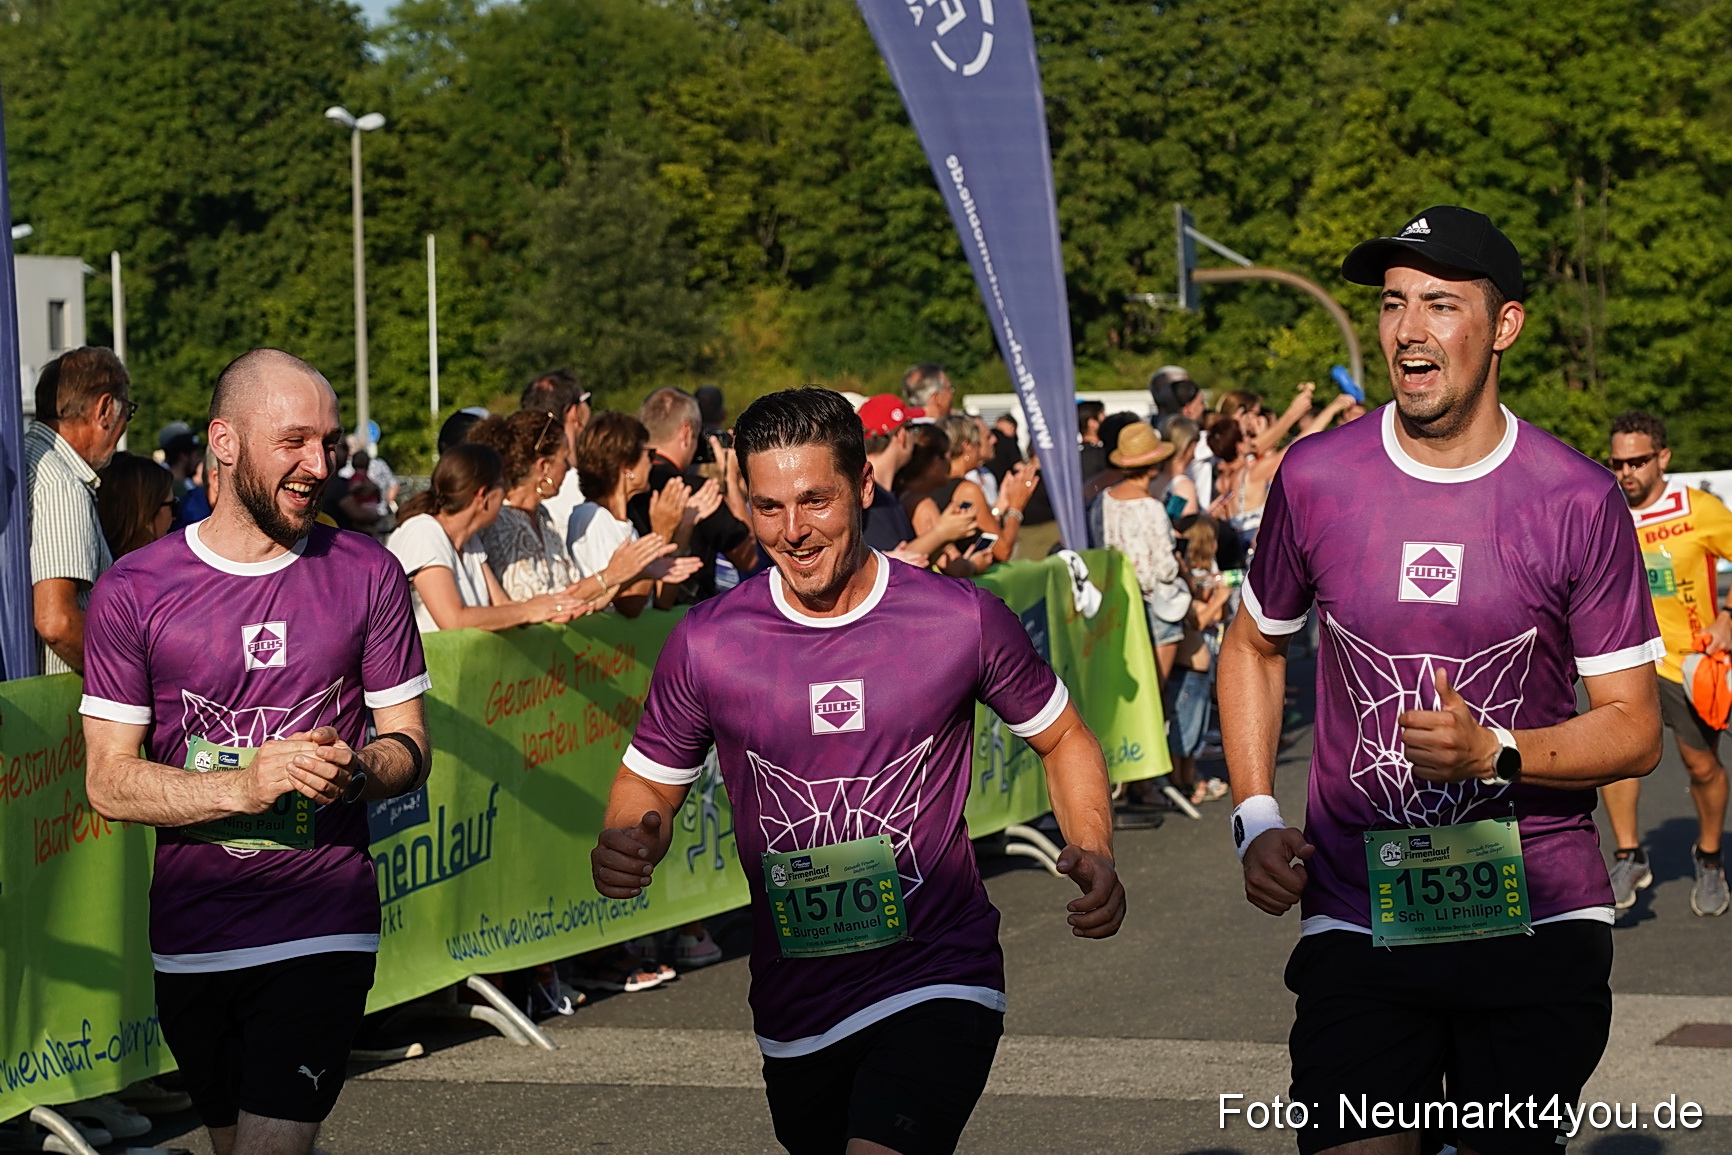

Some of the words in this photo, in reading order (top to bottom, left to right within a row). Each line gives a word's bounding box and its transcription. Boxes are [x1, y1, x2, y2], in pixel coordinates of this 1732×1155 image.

[1645, 522, 1694, 545] BÖGL
[1405, 566, 1457, 580] FUCHS
[247, 639, 283, 653] FUCHS
[485, 651, 568, 725] Gesunde
[573, 643, 636, 691] Firmen
[814, 700, 861, 714] FUCHS
[522, 710, 579, 772] laufen
[295, 790, 308, 835] 202
[257, 819, 285, 831] Paul
[1404, 846, 1450, 860] Firmenlauf
[1422, 854, 1451, 863] neumarkt
[788, 865, 829, 881] Firmenlauf
[1396, 861, 1499, 906] 1539
[785, 877, 878, 923] 1576
[1502, 863, 1522, 917] 2022
[879, 878, 900, 929] 2022
[1379, 883, 1395, 923] RUN
[1398, 910, 1425, 923] Sch
[1452, 904, 1503, 920] Philipp
[775, 901, 791, 937] RUN
[792, 925, 831, 939] Burger
[833, 915, 882, 934] Manuel
